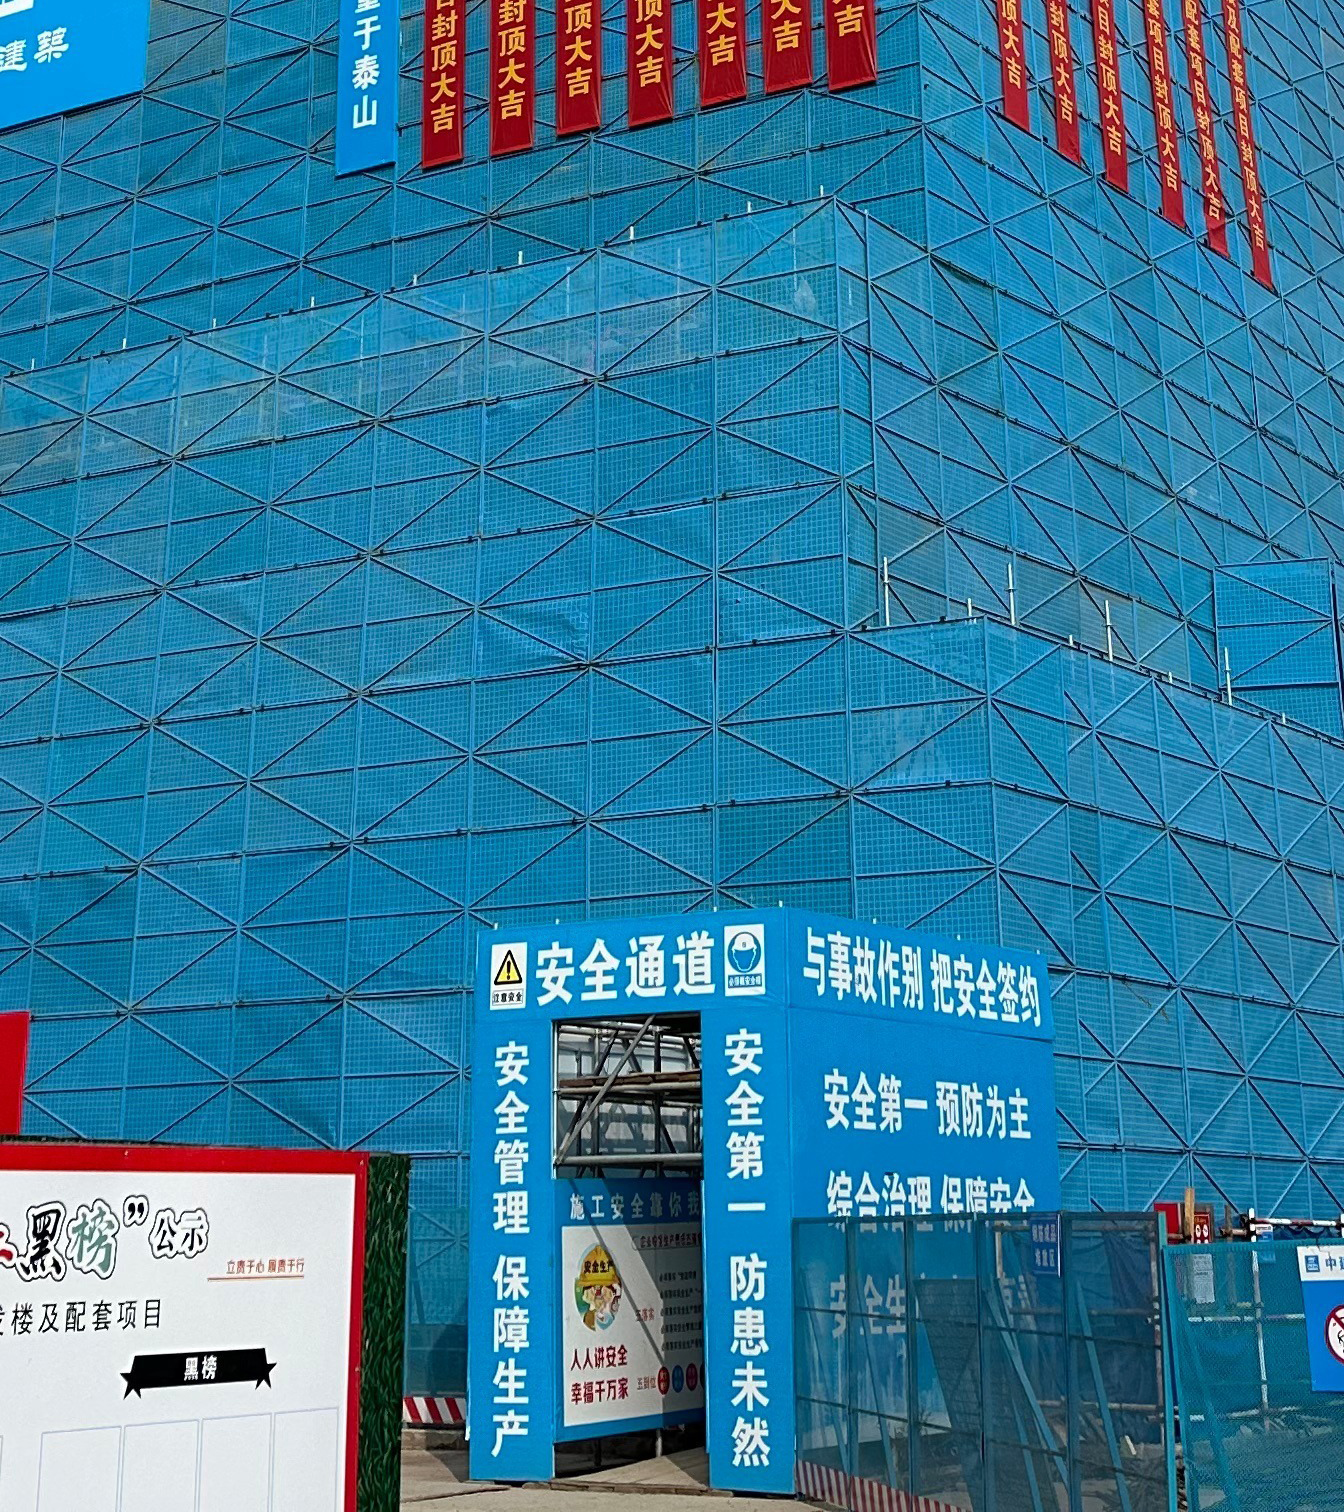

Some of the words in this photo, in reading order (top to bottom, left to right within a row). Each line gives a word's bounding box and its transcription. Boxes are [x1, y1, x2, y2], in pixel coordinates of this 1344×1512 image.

[492, 991, 524, 1004] 注意安全
[535, 930, 716, 1007] 安全通道
[802, 926, 924, 1011] 与事故作别
[930, 948, 1042, 1028] 把安全签约
[494, 1040, 530, 1235] 安全管理
[724, 1029, 766, 1212] 安全第一
[824, 1067, 928, 1134] 安全第一
[936, 1079, 1032, 1140] 预防为主
[827, 1170, 932, 1233] 综合治理
[184, 1354, 218, 1381] 黑榜
[492, 1254, 530, 1458] 保障生产
[570, 1343, 628, 1371] 人人讲安全
[570, 1377, 629, 1406] 幸福千万家
[729, 1253, 771, 1468] 防患未然
